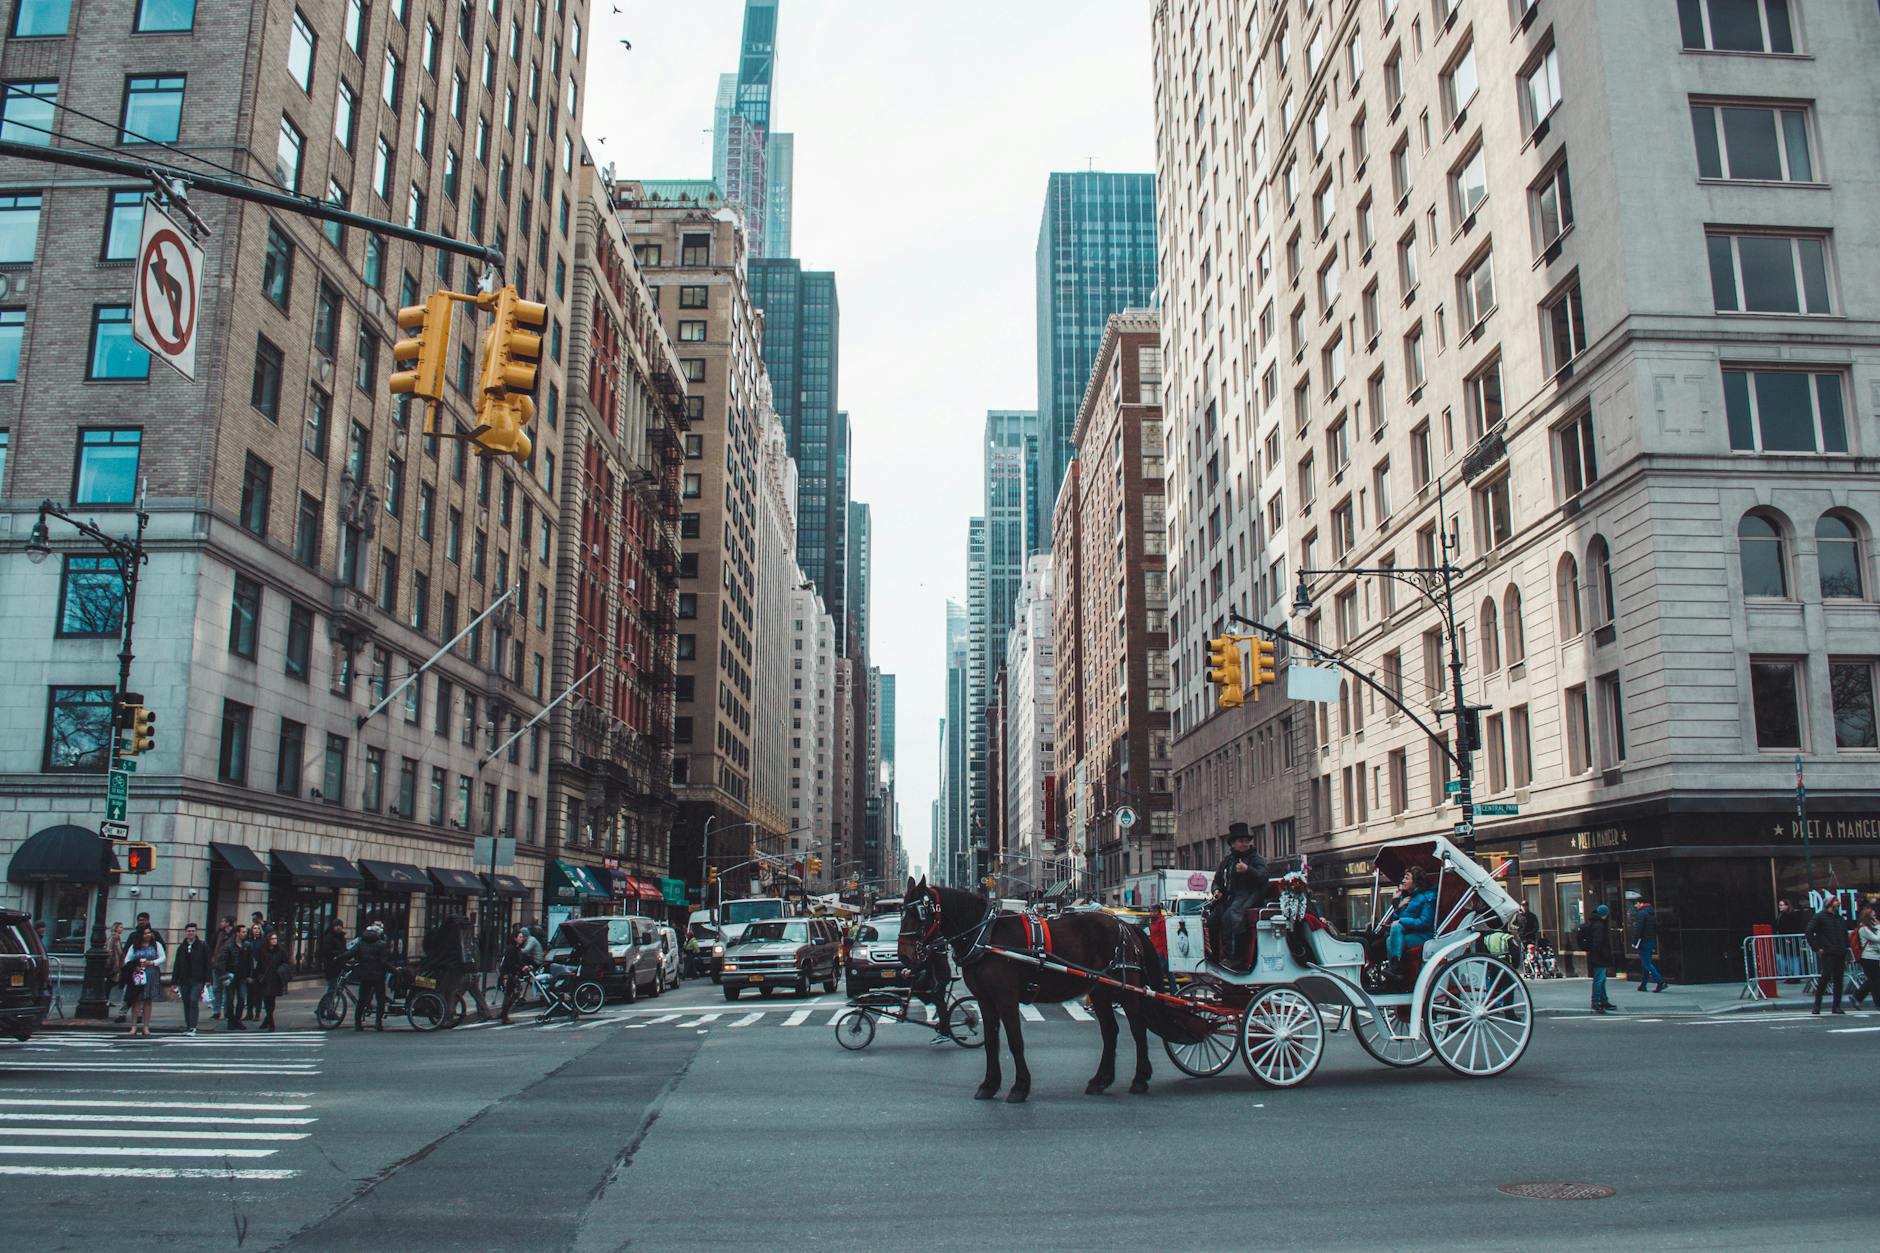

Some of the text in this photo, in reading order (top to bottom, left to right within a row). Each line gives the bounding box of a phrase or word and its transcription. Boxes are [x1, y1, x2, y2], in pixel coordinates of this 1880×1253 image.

[1482, 804, 1504, 812] CENTRAL
[1825, 820, 1833, 839] A
[1808, 888, 1859, 921] PET
